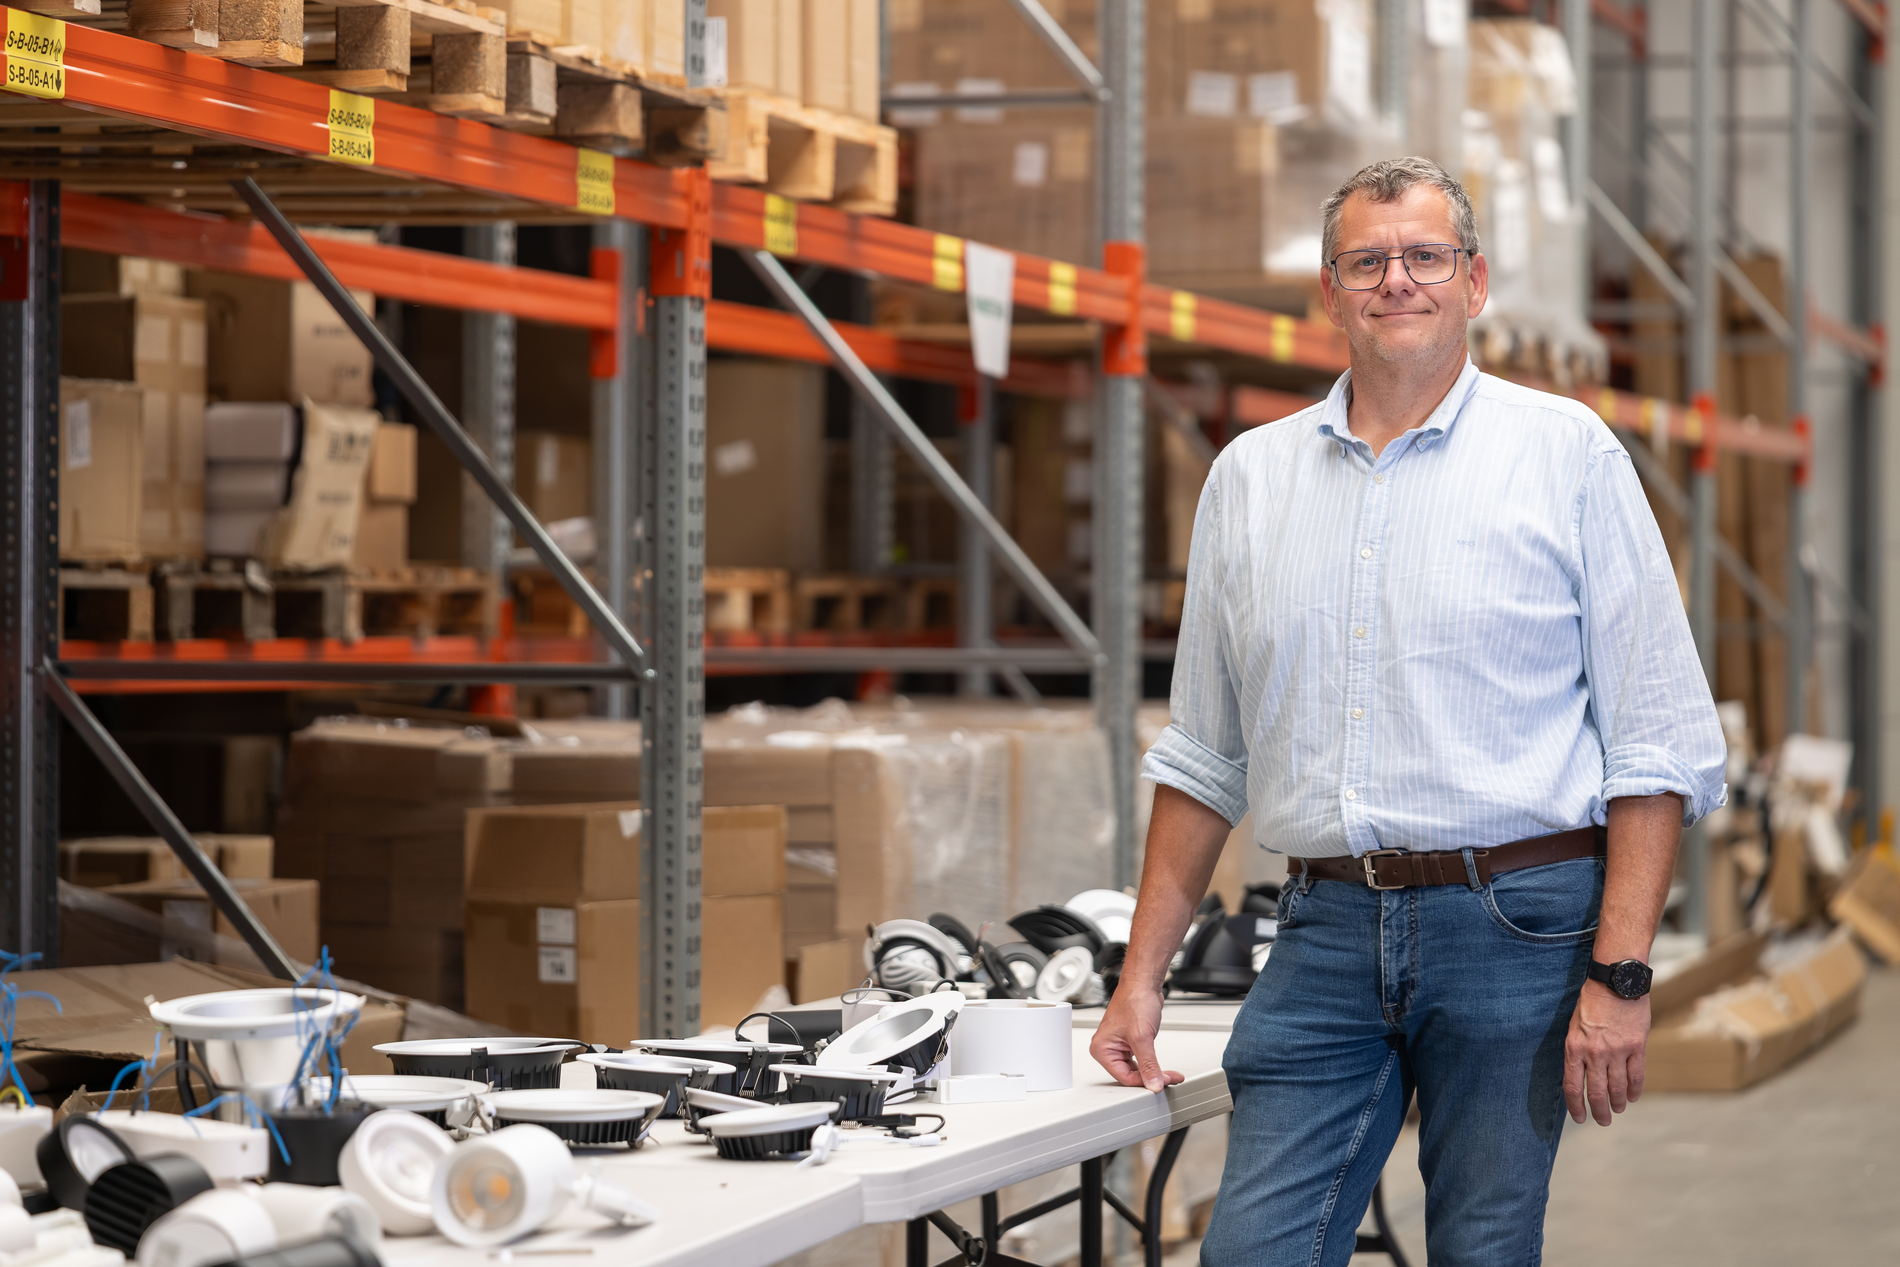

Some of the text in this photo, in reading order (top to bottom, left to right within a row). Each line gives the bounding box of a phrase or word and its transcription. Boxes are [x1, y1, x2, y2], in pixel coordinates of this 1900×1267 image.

[7, 30, 54, 56] S-B-05-B1
[8, 64, 54, 90] S-B-05-A1
[329, 108, 367, 129] S-B-05-B2
[331, 138, 367, 159] S-B-05-A2
